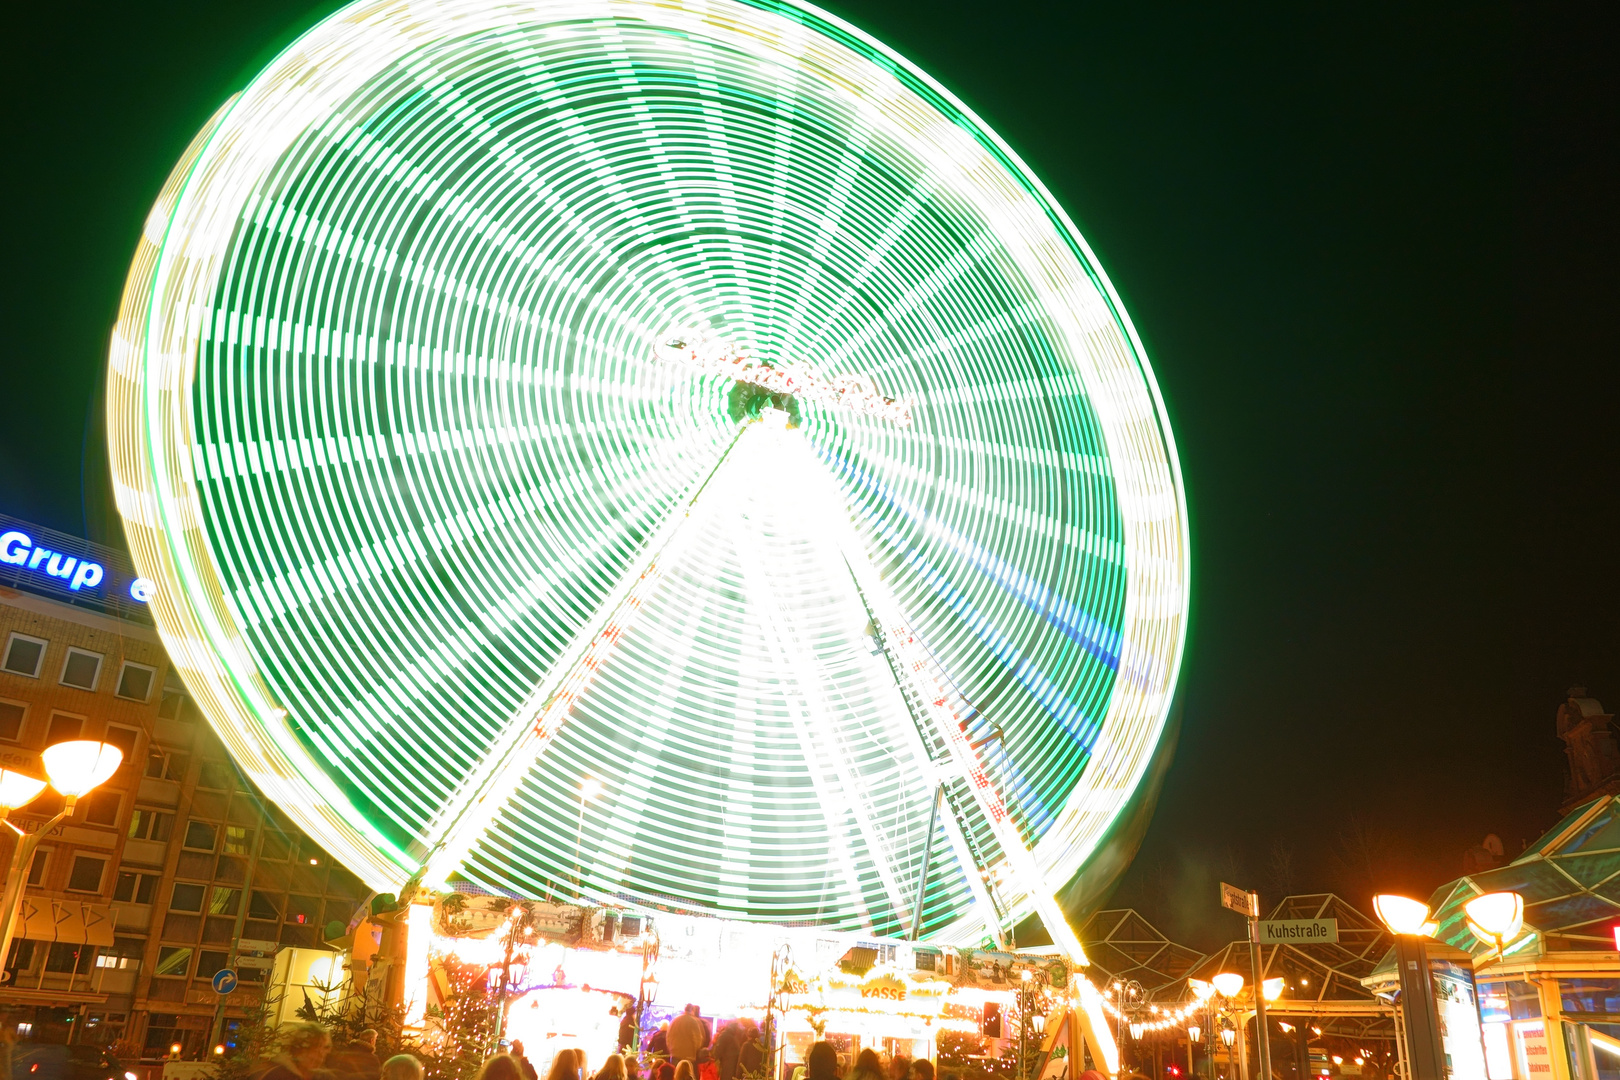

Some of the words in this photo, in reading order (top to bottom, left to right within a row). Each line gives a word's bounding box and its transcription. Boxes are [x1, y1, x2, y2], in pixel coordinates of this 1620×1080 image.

[36, 820, 66, 837] PST
[1267, 923, 1327, 938] Kuhstraße
[861, 986, 907, 1001] KASSE
